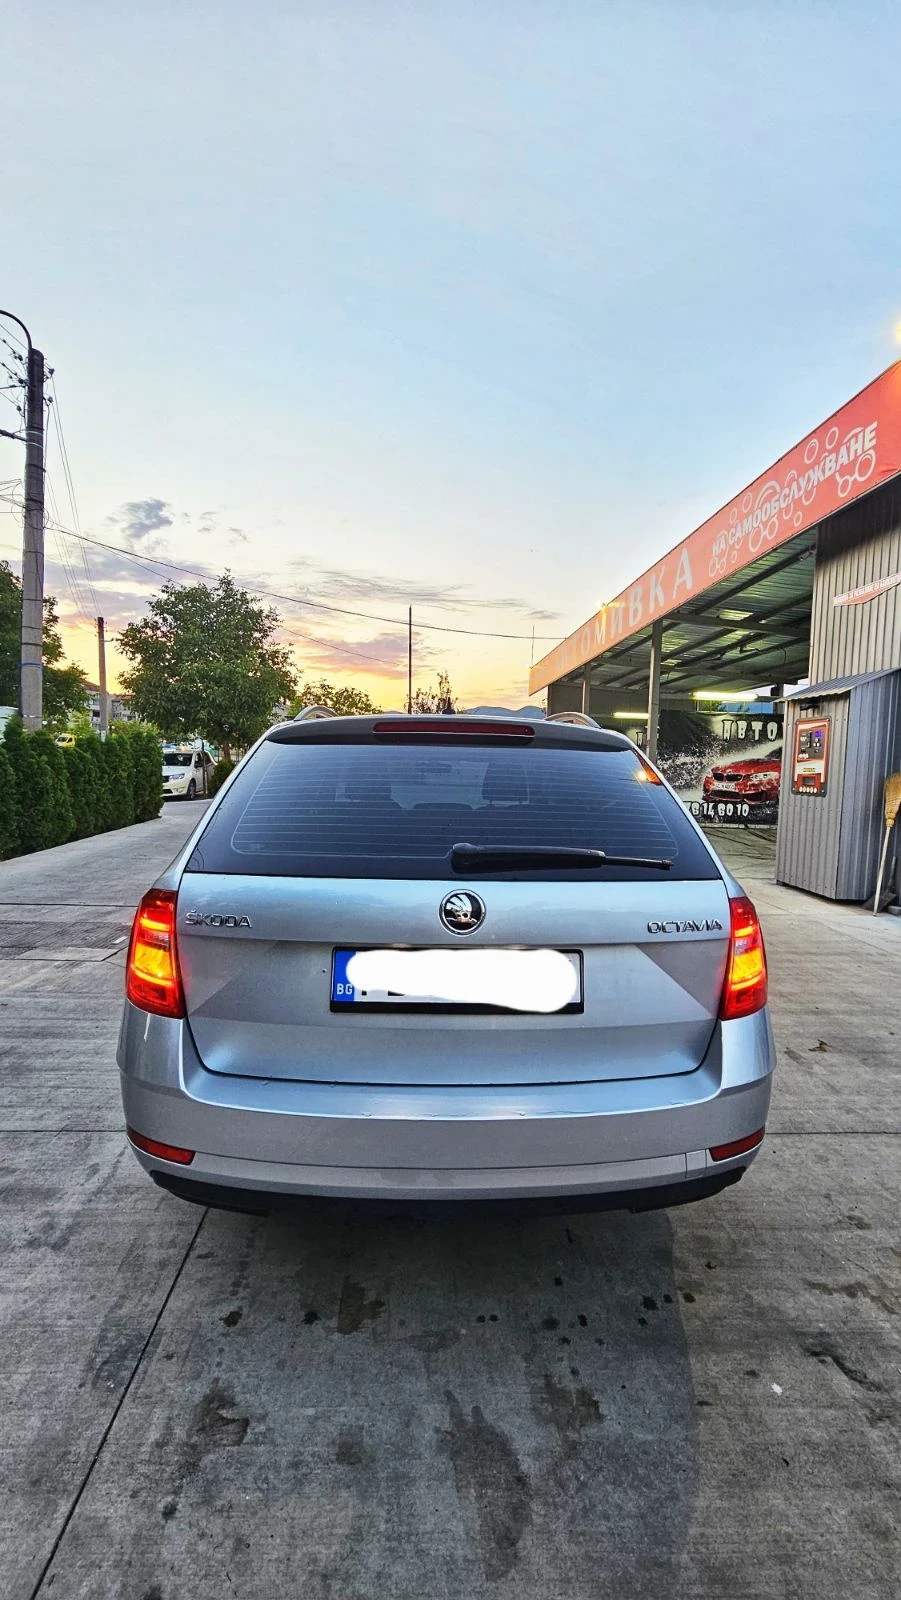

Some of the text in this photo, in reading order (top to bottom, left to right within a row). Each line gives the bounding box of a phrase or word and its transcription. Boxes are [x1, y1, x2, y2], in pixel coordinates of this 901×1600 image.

[712, 534, 728, 557] НА
[728, 421, 878, 545] САМООБСЛУЖВАНЕ
[722, 720, 784, 742] АВТО
[702, 802, 715, 818] 14
[735, 803, 750, 817] 10
[185, 910, 253, 928] ŠKODA
[647, 919, 723, 933] OCTAVIA
[336, 983, 353, 995] BG
